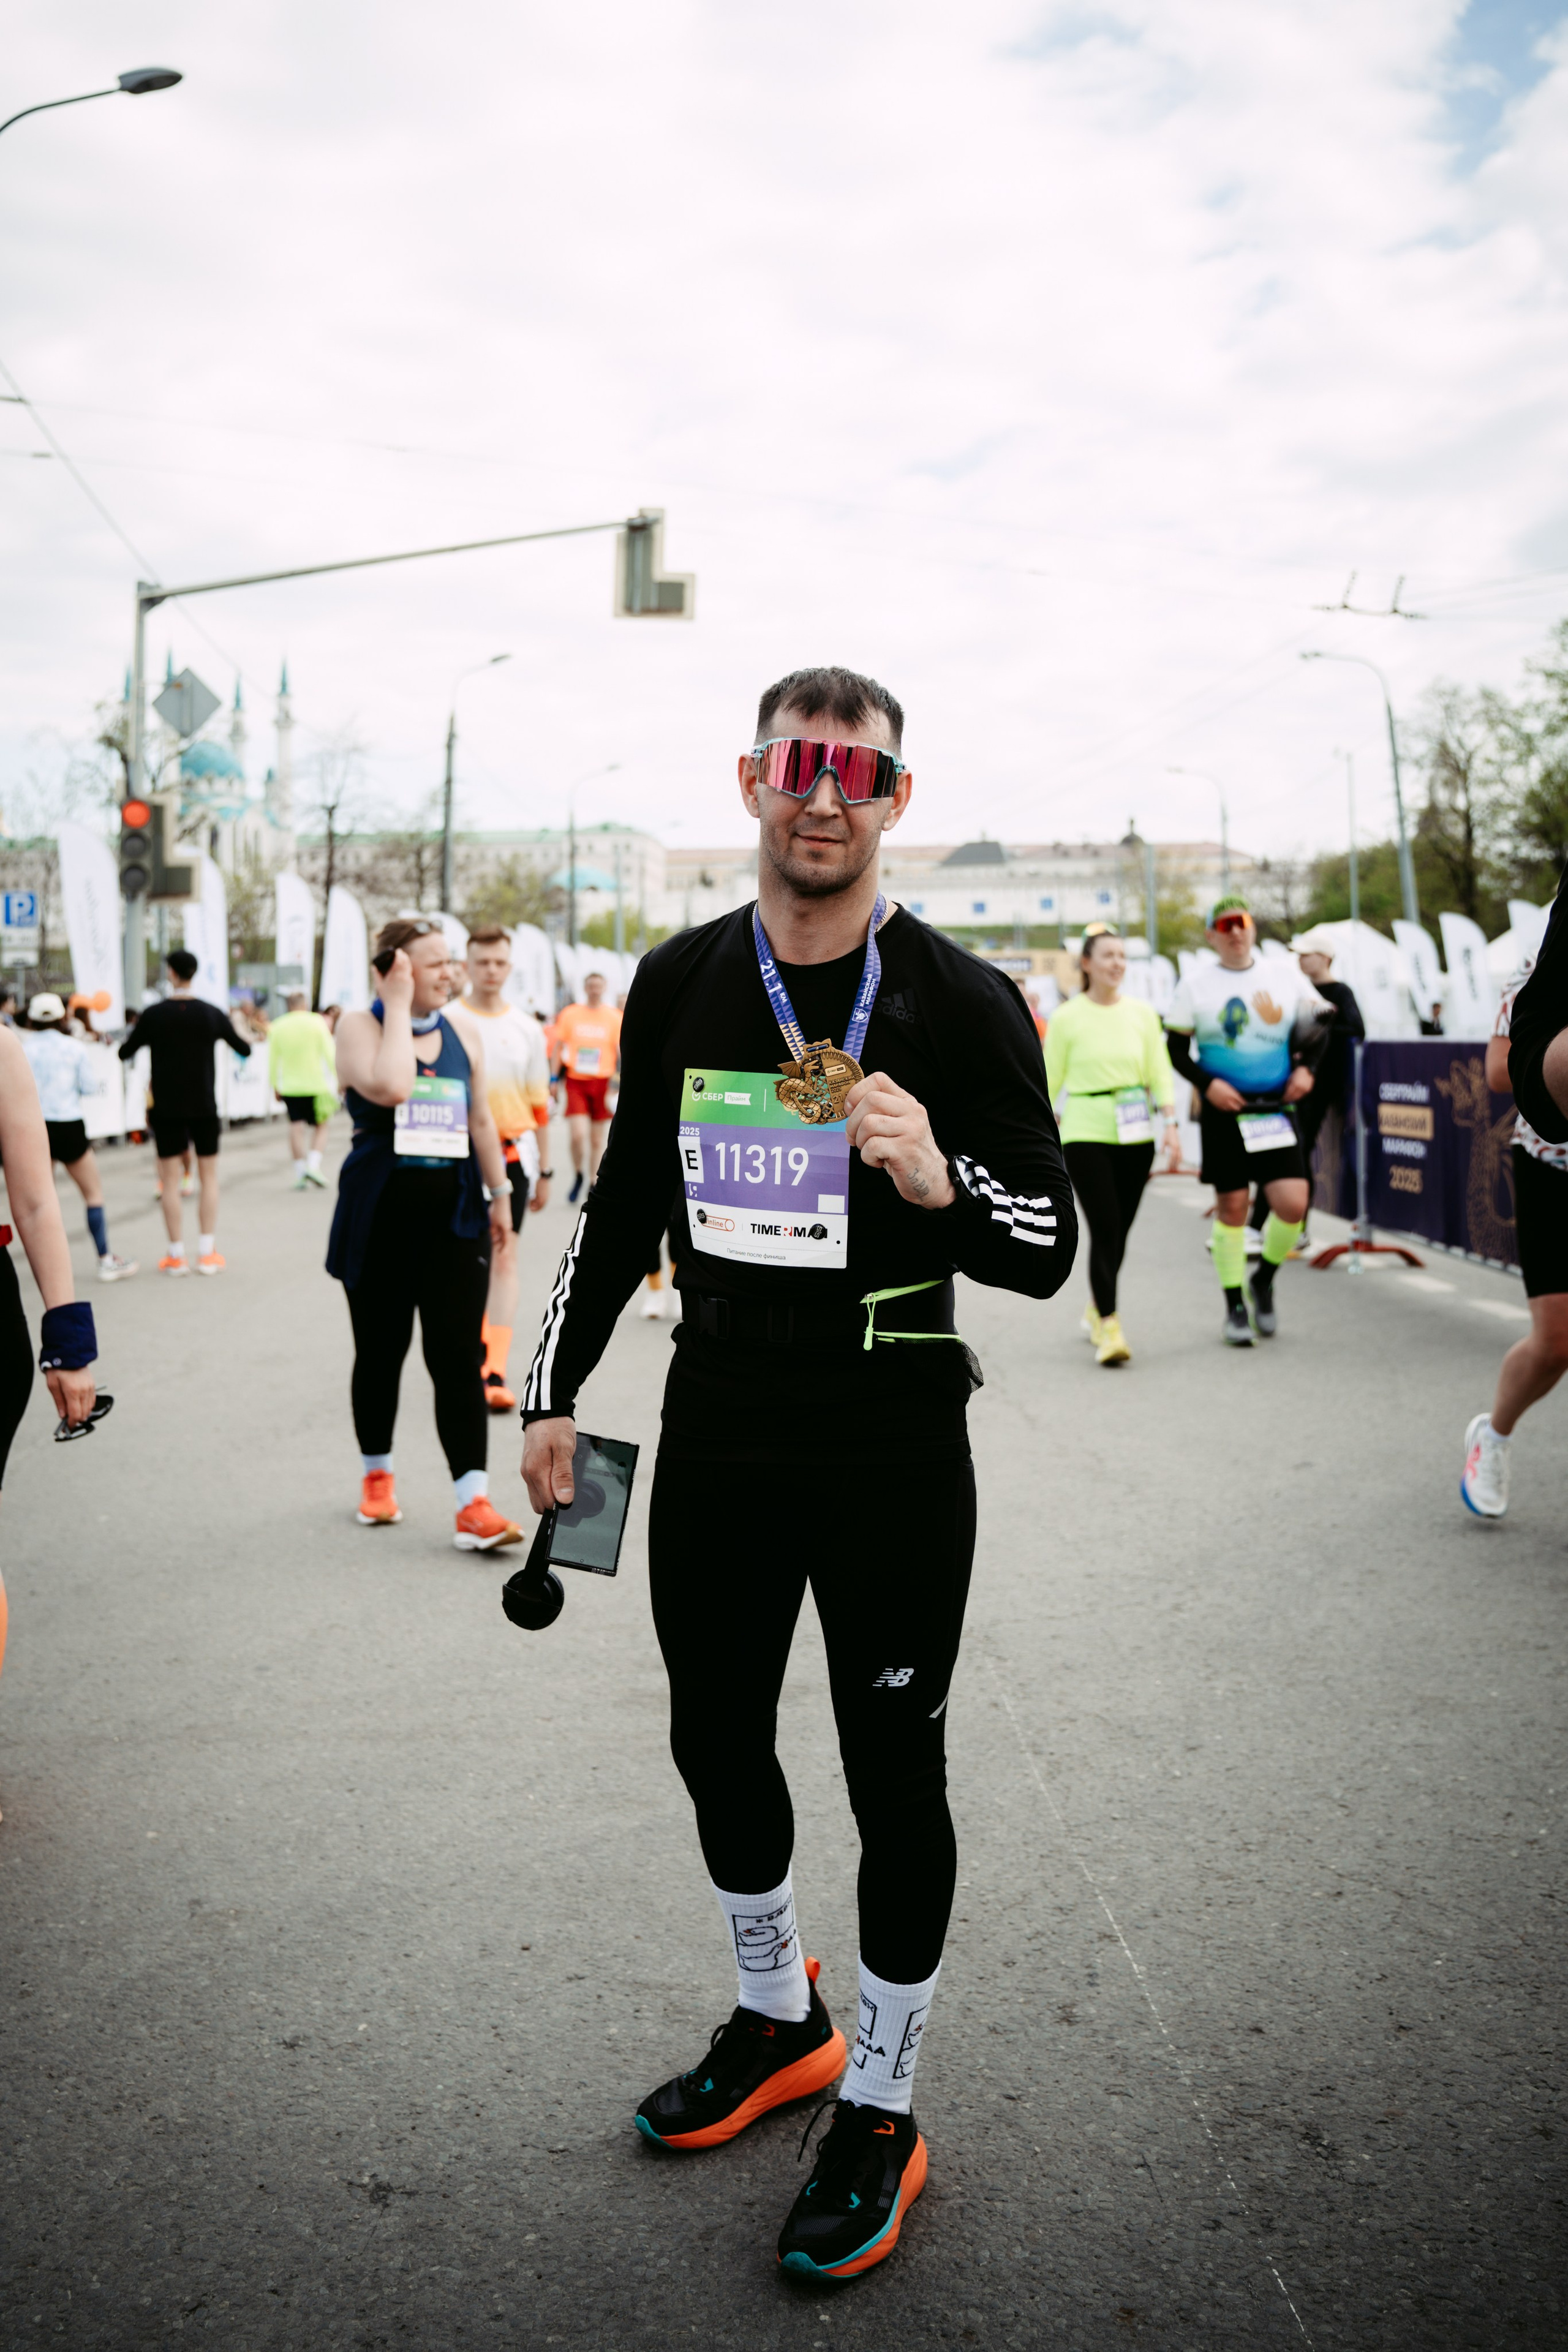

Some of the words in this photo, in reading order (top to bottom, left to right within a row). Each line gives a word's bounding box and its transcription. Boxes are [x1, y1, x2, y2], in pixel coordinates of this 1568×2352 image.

[859, 973, 873, 1007] КАЗАНСКИЙ
[865, 978, 876, 1005] МАРАФОН
[873, 1003, 922, 1025] adidas
[702, 1092, 723, 1101] СБЕР
[680, 1126, 700, 1136] 2025
[685, 1149, 698, 1170] E
[715, 1142, 809, 1186] 11319
[1390, 1165, 1423, 1194] 2025
[705, 1219, 723, 1227] inline
[727, 1248, 746, 1256] Питание
